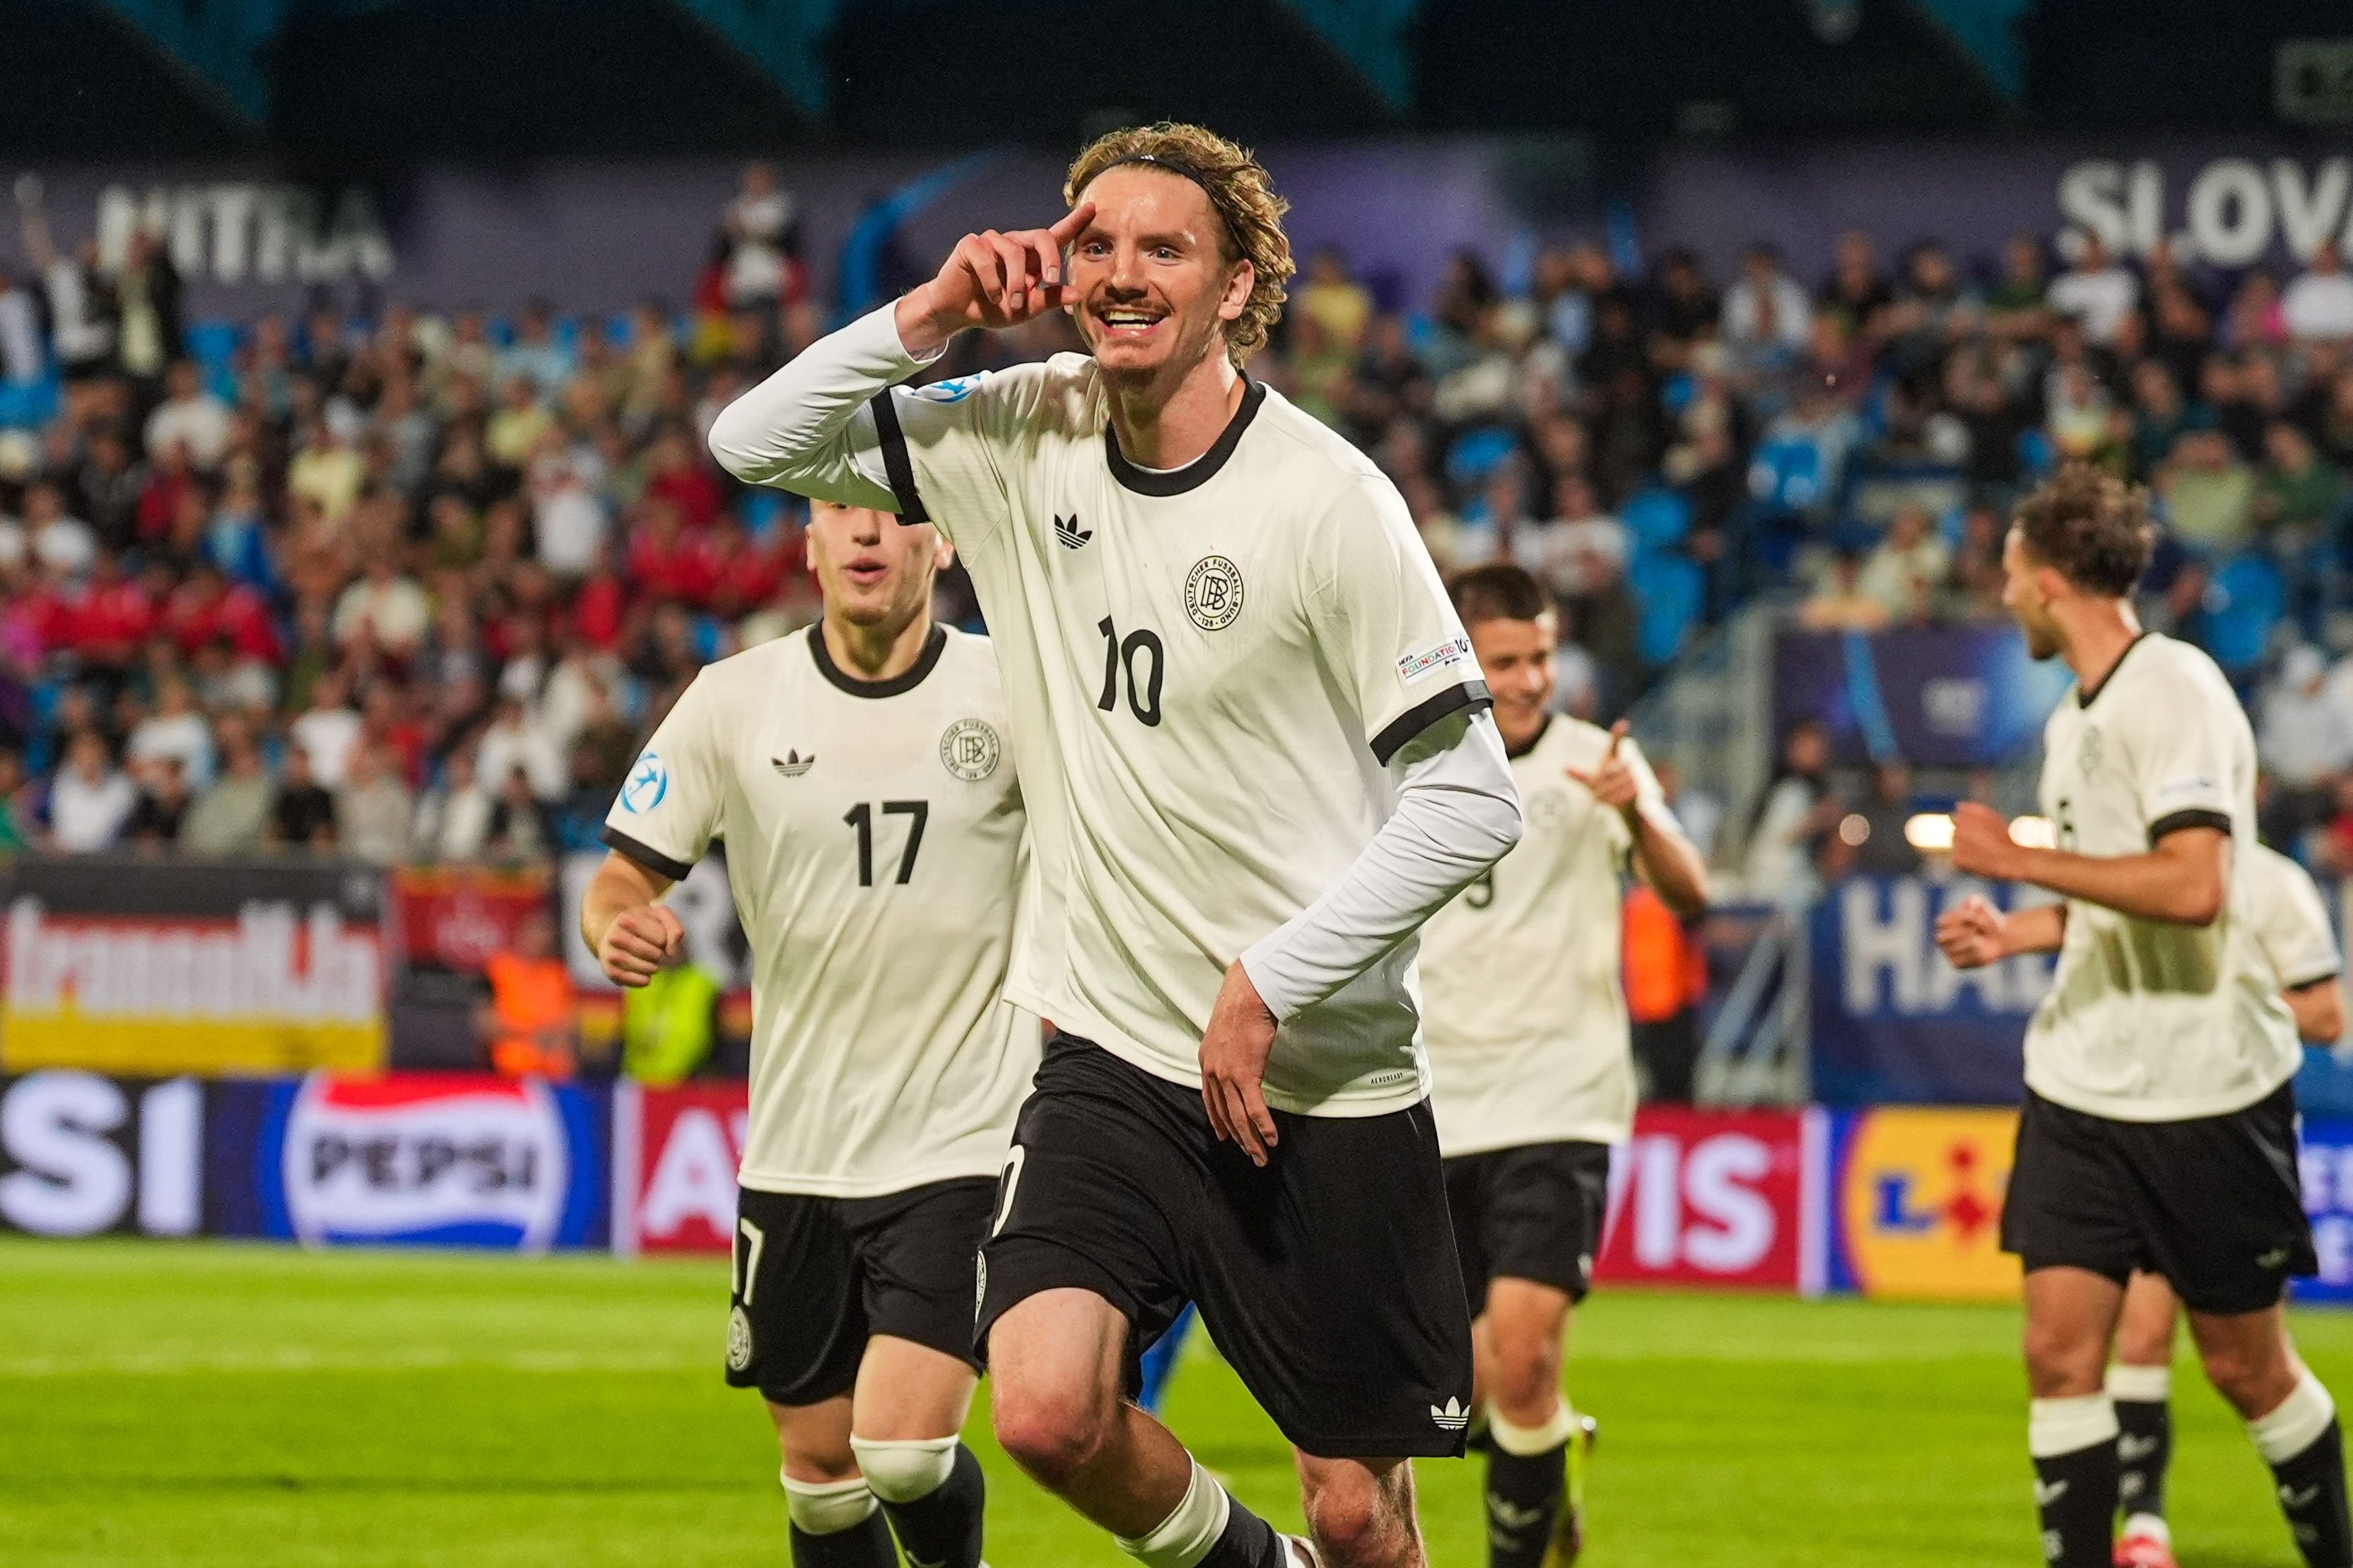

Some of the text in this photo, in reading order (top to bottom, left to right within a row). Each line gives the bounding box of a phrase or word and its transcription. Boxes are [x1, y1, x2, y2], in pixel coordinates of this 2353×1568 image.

[2058, 157, 2353, 267] SLOV
[1187, 561, 1208, 616] DEUTSCHER
[1098, 613, 1163, 727] 10
[843, 799, 928, 887] 17
[1371, 1072, 1403, 1085] AEROREADY
[311, 1135, 540, 1191] PEPSI
